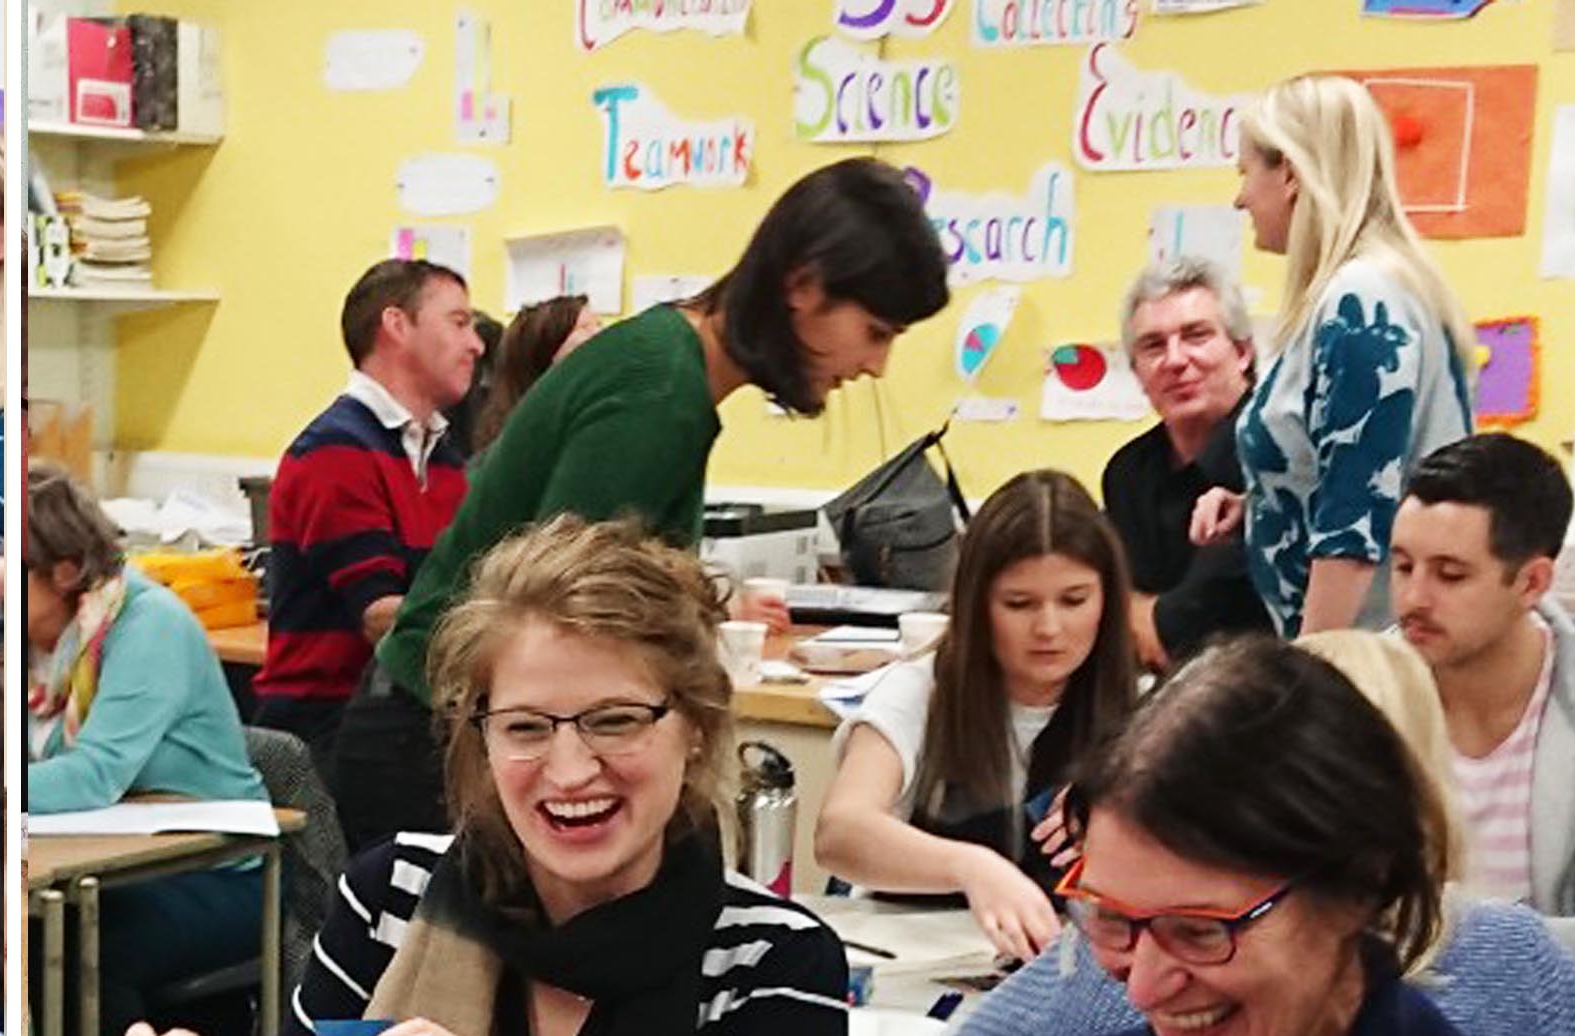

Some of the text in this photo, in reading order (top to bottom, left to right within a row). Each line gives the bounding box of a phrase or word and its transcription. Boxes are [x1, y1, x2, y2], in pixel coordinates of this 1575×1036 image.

[592, 86, 749, 181] Teamwork
[796, 36, 952, 136] Science
[1081, 43, 1235, 162] Evidenc
[904, 166, 1068, 264] search
